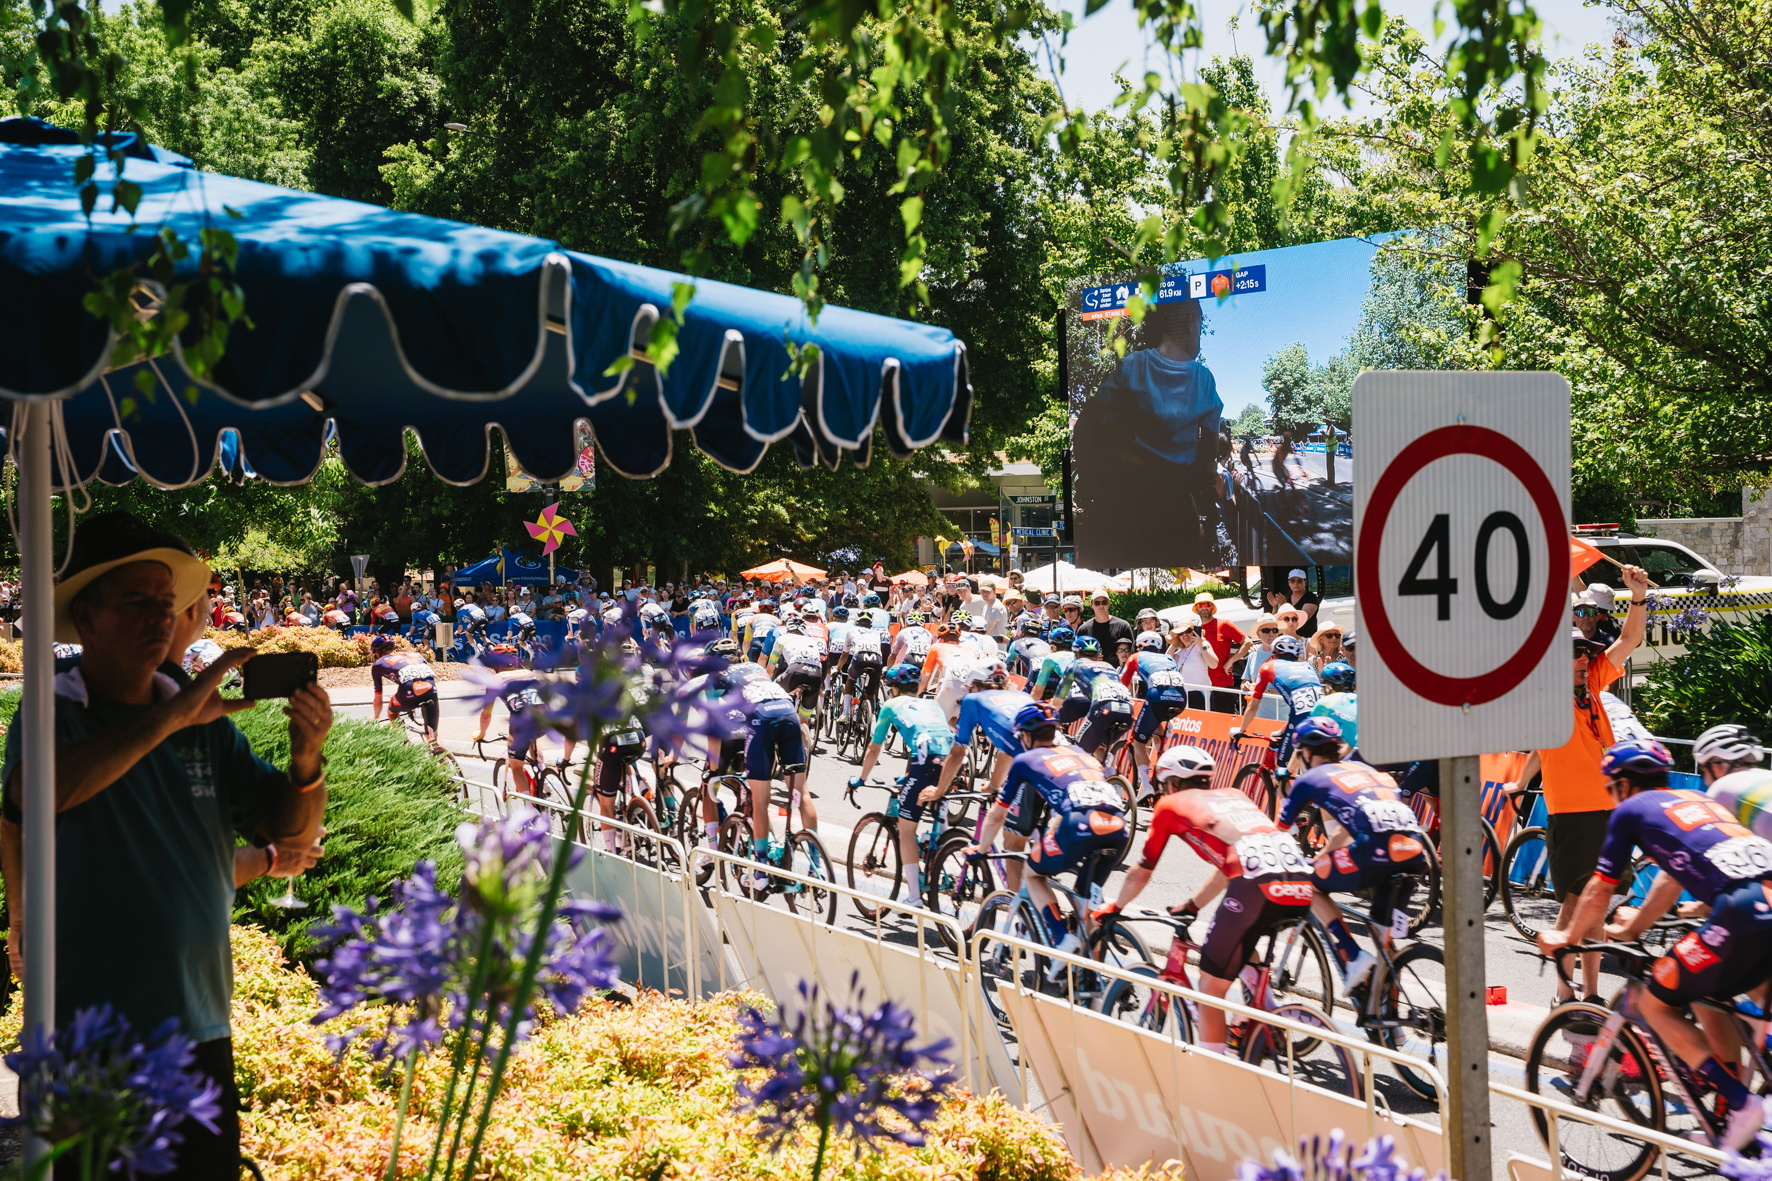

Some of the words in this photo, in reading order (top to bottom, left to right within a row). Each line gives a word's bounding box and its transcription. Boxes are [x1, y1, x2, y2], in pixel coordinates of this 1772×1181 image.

[1235, 271, 1248, 279] GAP
[1194, 281, 1202, 291] P
[1159, 289, 1173, 298] 61.9
[1016, 496, 1042, 504] JOHNSTON
[1016, 528, 1034, 536] MEDICAL
[1398, 510, 1530, 621] 40
[900, 778, 918, 806] ASTANA
[1268, 883, 1313, 900] caps
